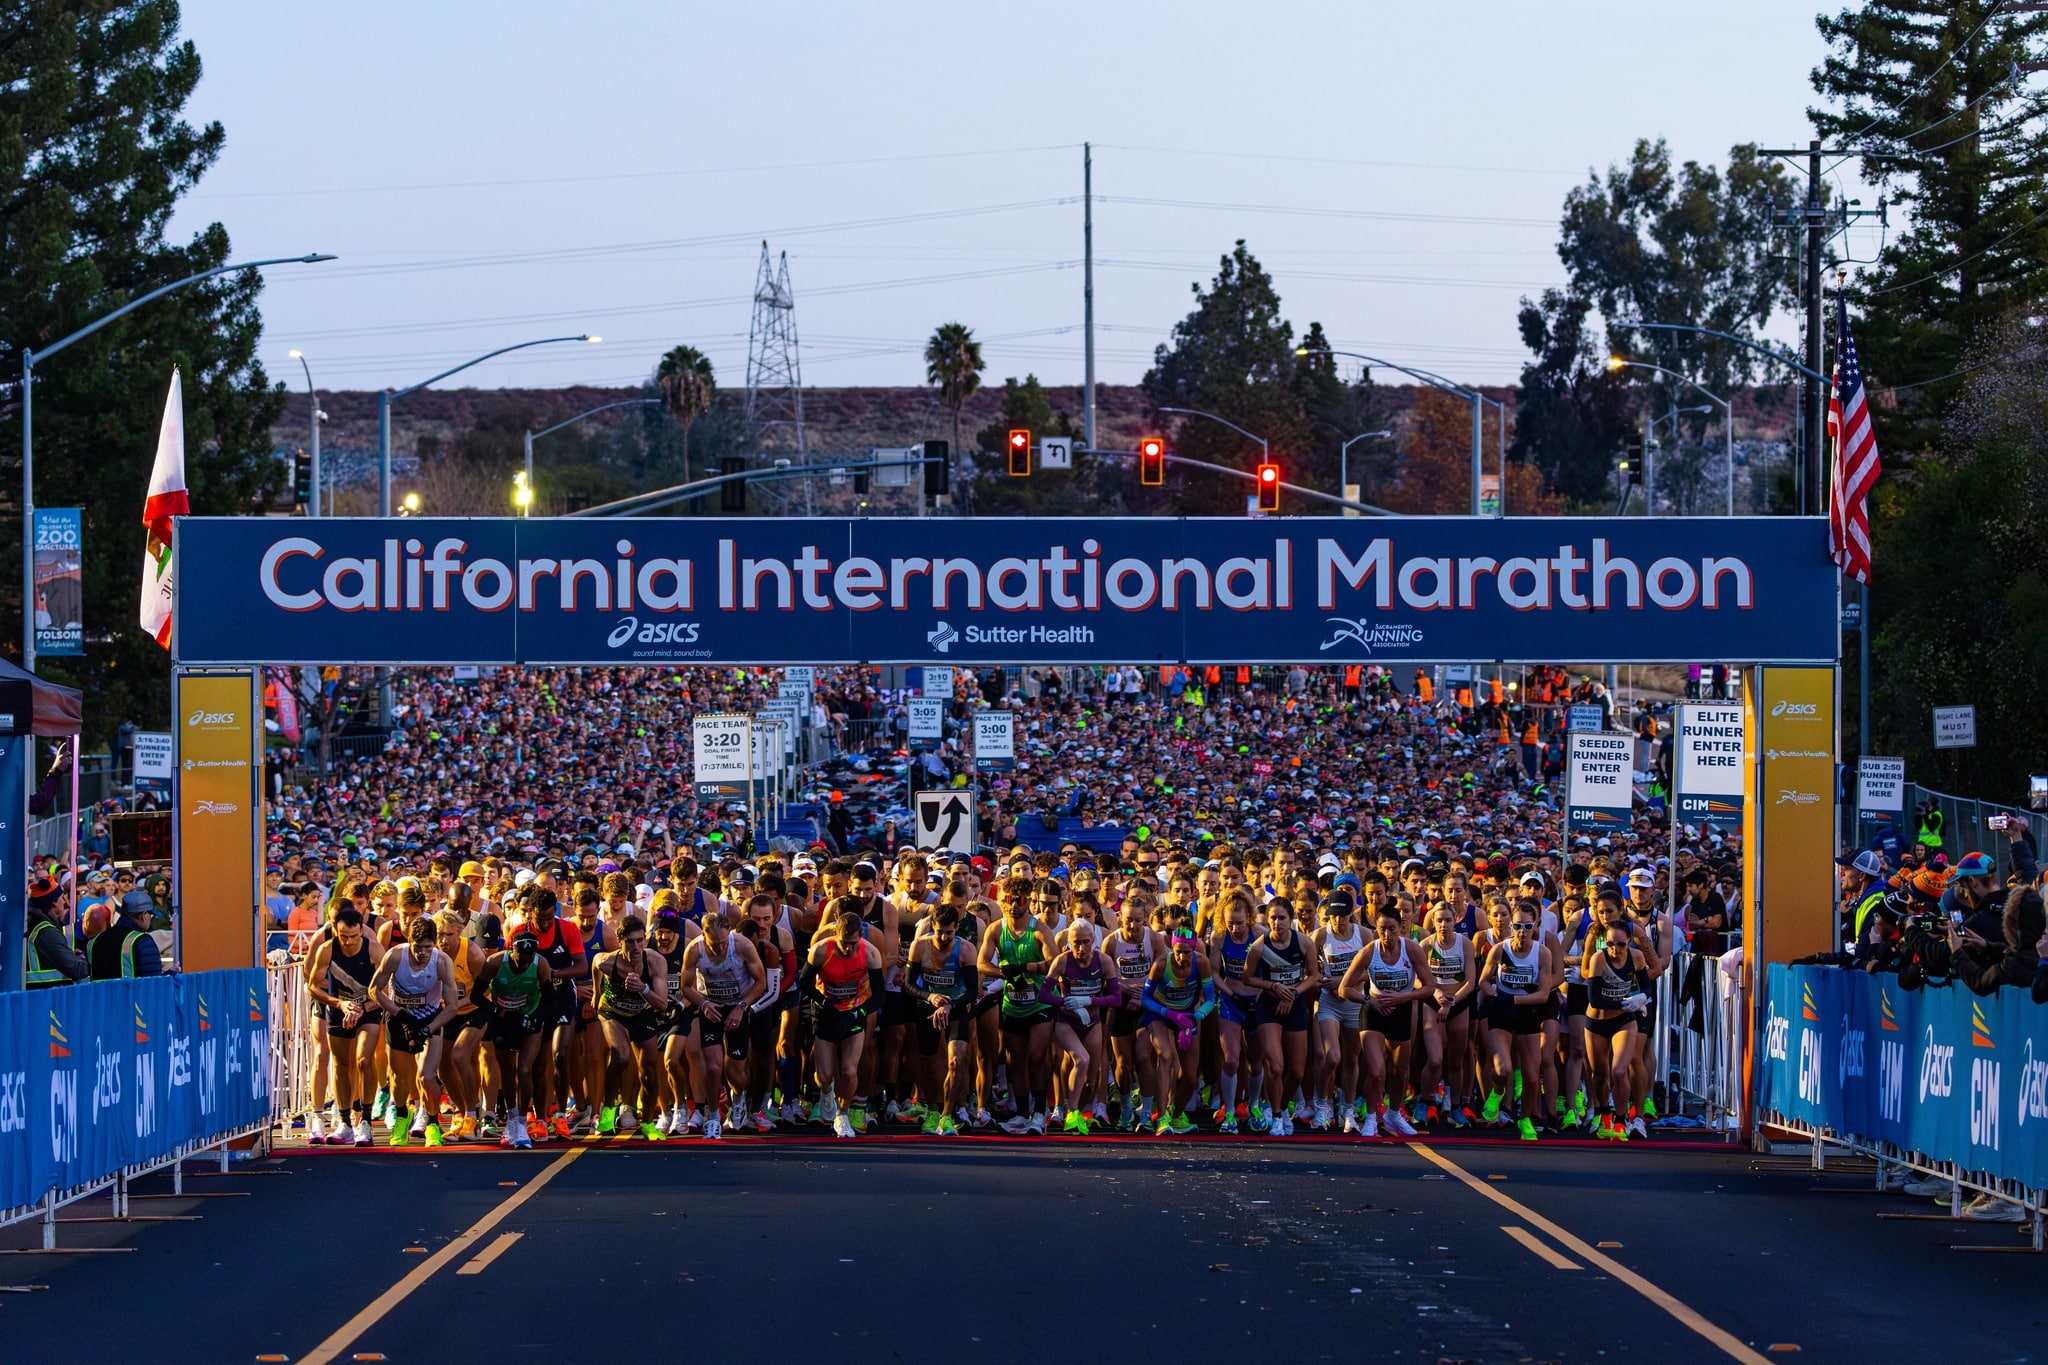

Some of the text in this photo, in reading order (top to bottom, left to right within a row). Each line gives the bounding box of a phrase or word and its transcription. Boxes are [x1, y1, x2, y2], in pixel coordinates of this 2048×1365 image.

[38, 530, 76, 544] ZOO
[260, 536, 1754, 612] California International Marathon
[37, 631, 81, 640] FOLSOM
[965, 626, 1094, 645] Sutter Health
[695, 650, 713, 658] body
[929, 673, 948, 681] 3:10
[784, 690, 805, 698] 3:50
[913, 708, 936, 716] 3:05
[1698, 711, 1739, 722] ELITE
[695, 721, 719, 729] PACE
[981, 724, 1007, 734] 3:00
[1682, 726, 1743, 737] RUNNER
[703, 733, 740, 747] 3:20
[1579, 739, 1625, 749] SEEDED
[1693, 741, 1741, 752] ENTER
[1573, 751, 1630, 761] RUNNERS
[1697, 756, 1736, 766] HERE
[700, 763, 745, 772] (7:37/MILE)
[1254, 763, 1272, 772] 3:05
[1581, 763, 1621, 773] ENTER
[1585, 775, 1617, 784] HERE
[1860, 772, 1903, 780] RUNNERS
[700, 785, 719, 794] CIM
[1682, 799, 1709, 811] CIM
[1572, 810, 1595, 820] CIM
[1861, 811, 1877, 819] CIM
[441, 819, 460, 829] 3:35
[1123, 965, 1150, 973] GRACEY
[1330, 962, 1351, 970] GAUGH
[1504, 974, 1529, 983] FEIVOR
[1799, 1027, 1823, 1105] CIM
[1929, 1043, 1954, 1098] asics
[199, 1038, 217, 1116] CIM
[1880, 1040, 1904, 1123] CIM
[136, 1051, 156, 1138] CIM
[1, 1071, 26, 1133] asics
[1970, 1058, 2001, 1151] CIM
[50, 1069, 78, 1164] CIM
